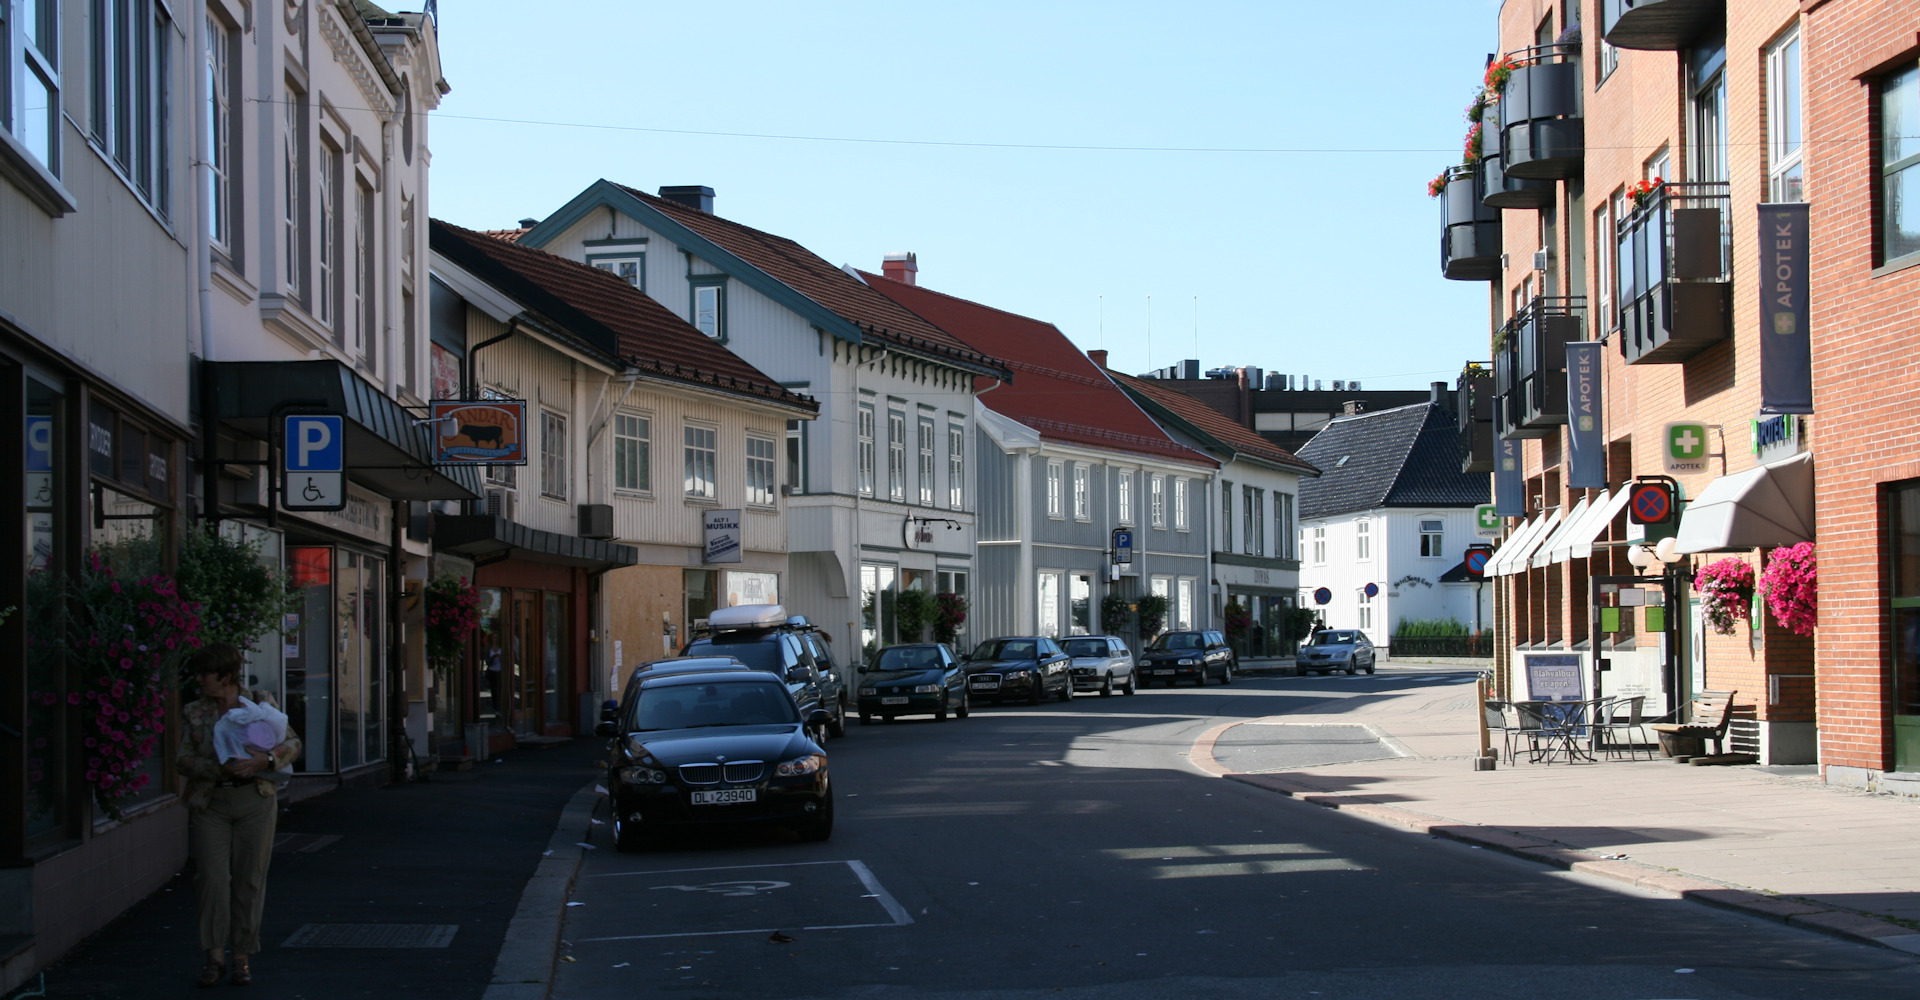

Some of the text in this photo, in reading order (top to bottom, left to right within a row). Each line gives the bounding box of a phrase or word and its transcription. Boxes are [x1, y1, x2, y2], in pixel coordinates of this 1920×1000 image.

[298, 420, 331, 467] P
[706, 522, 739, 530] MUSIKK
[1119, 535, 1128, 547] P
